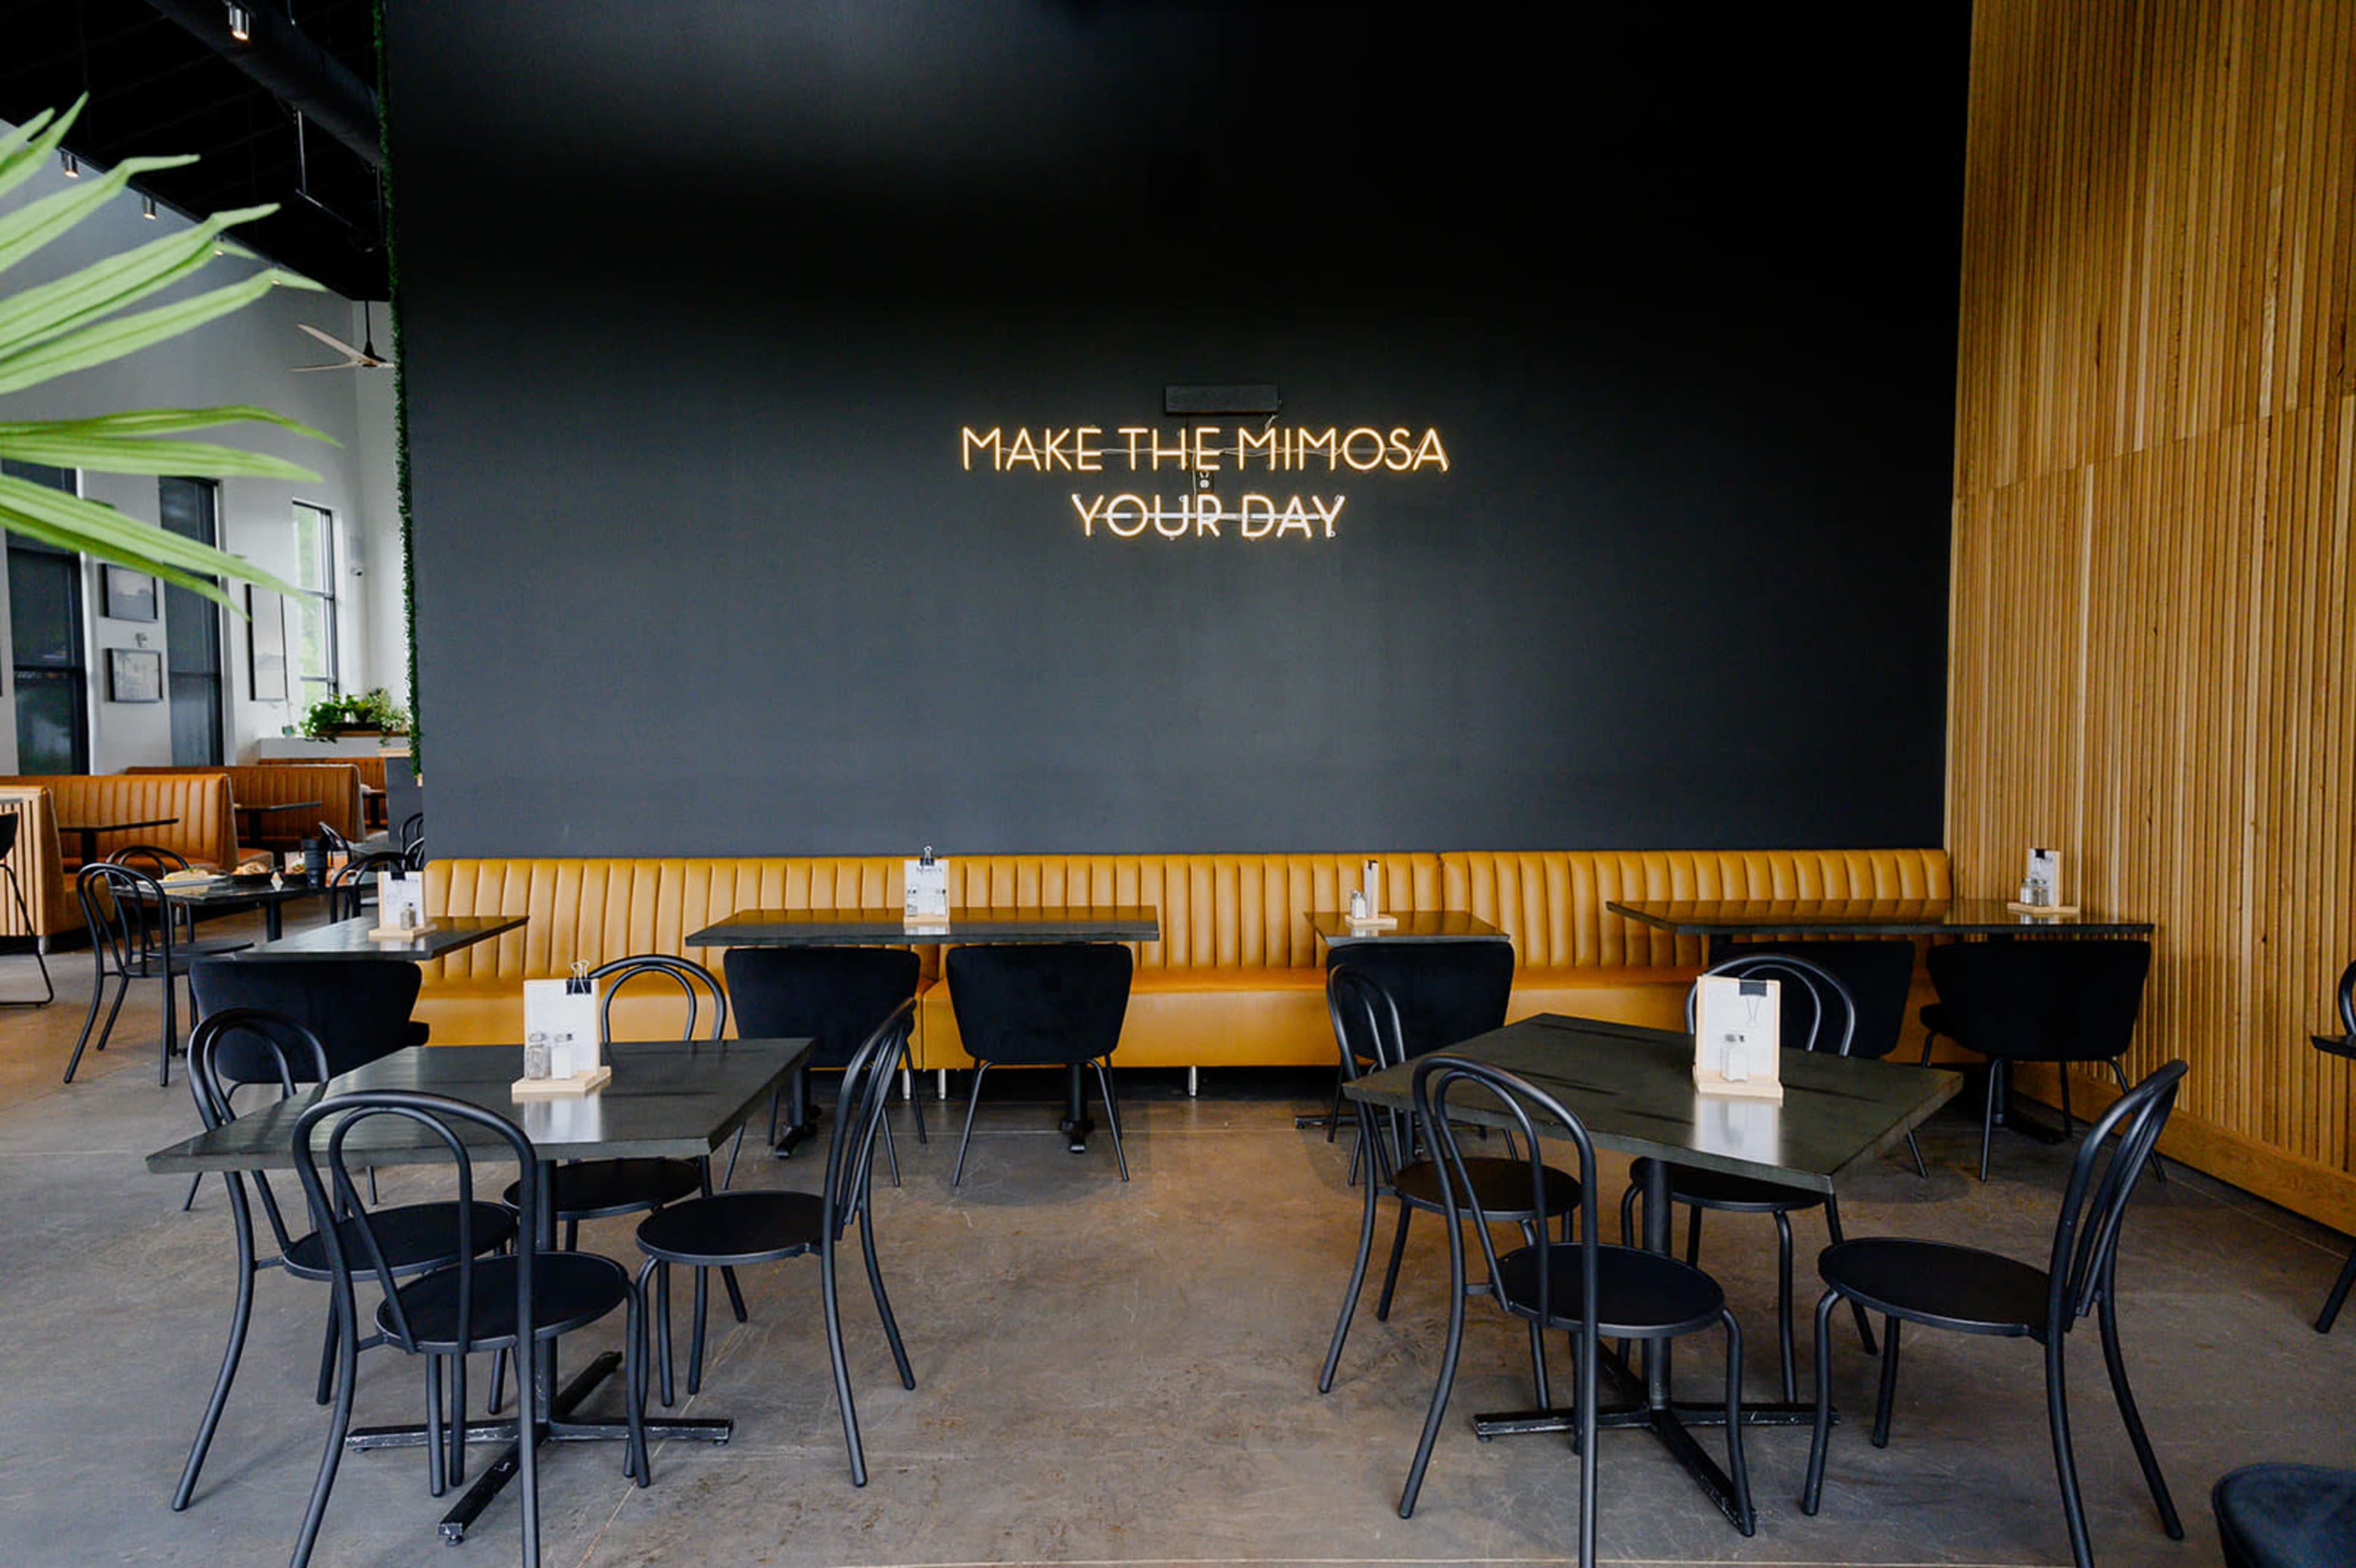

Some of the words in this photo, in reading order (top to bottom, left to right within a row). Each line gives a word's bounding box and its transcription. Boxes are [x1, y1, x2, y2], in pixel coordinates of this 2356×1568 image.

[962, 427, 1103, 471] MAKE
[1118, 427, 1221, 471] THE
[1238, 427, 1449, 471] MIMOSA
[1072, 494, 1222, 538] YOUR
[1241, 494, 1345, 538] DAY
